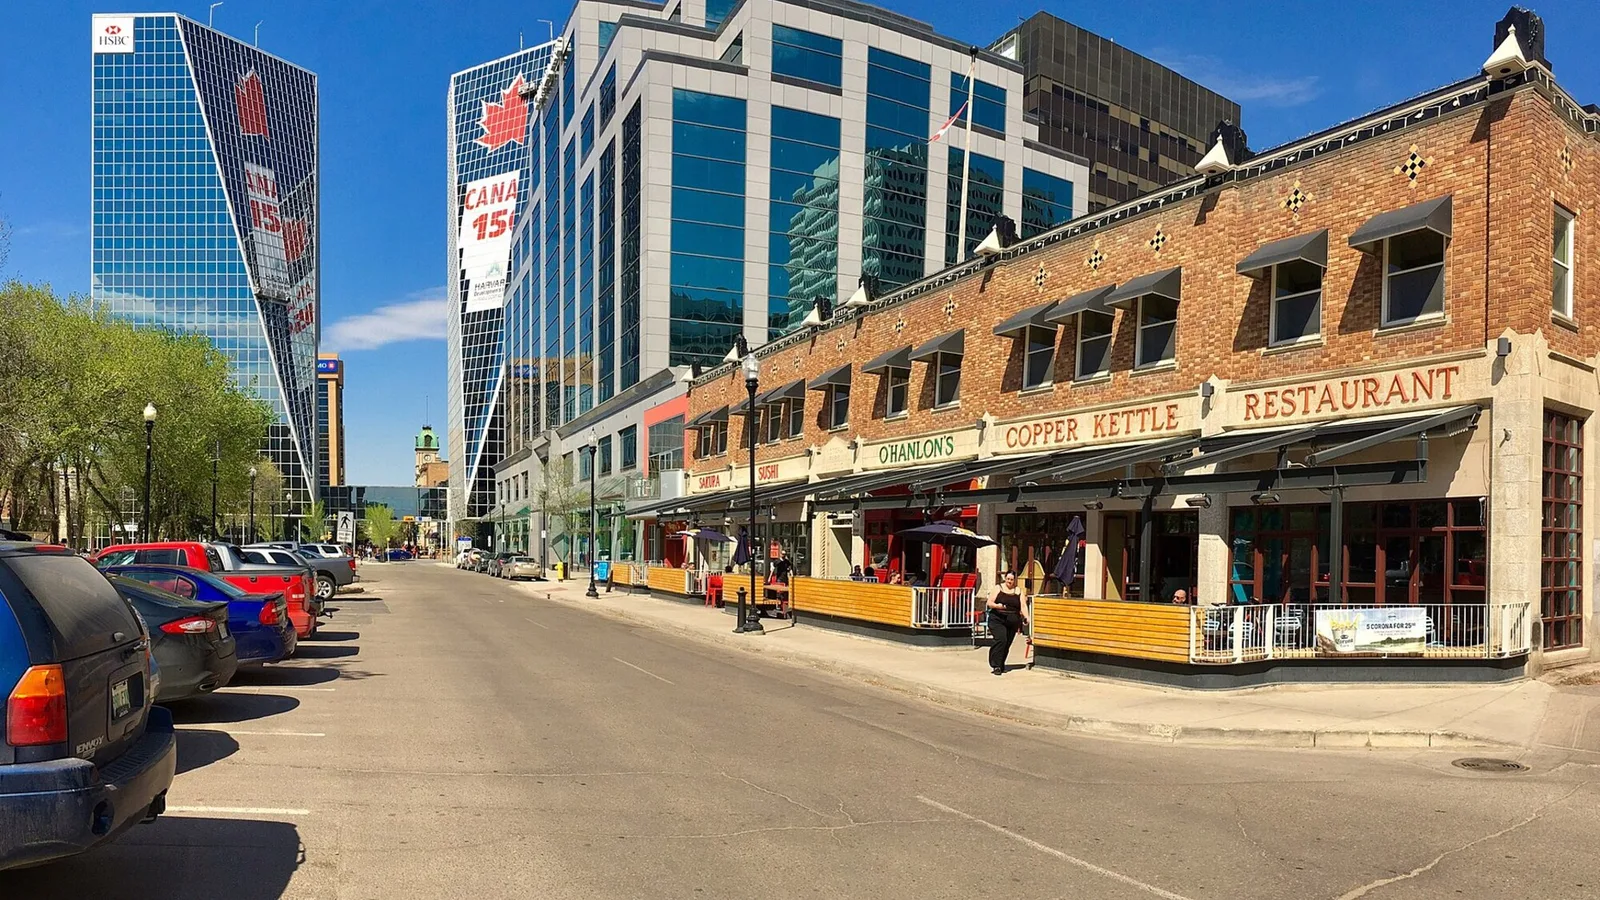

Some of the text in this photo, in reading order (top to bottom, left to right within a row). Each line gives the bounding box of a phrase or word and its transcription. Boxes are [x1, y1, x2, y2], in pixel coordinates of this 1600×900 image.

[99, 35, 130, 46] HSBC
[465, 178, 518, 210] CANA
[1243, 365, 1460, 421] RESTAURANT
[1005, 403, 1179, 448] COPPER KETTLE
[878, 435, 954, 465] O'HANLON'S
[699, 474, 721, 489] SAKURA
[758, 464, 779, 481] SUSHI
[76, 735, 104, 755] ENVOY
